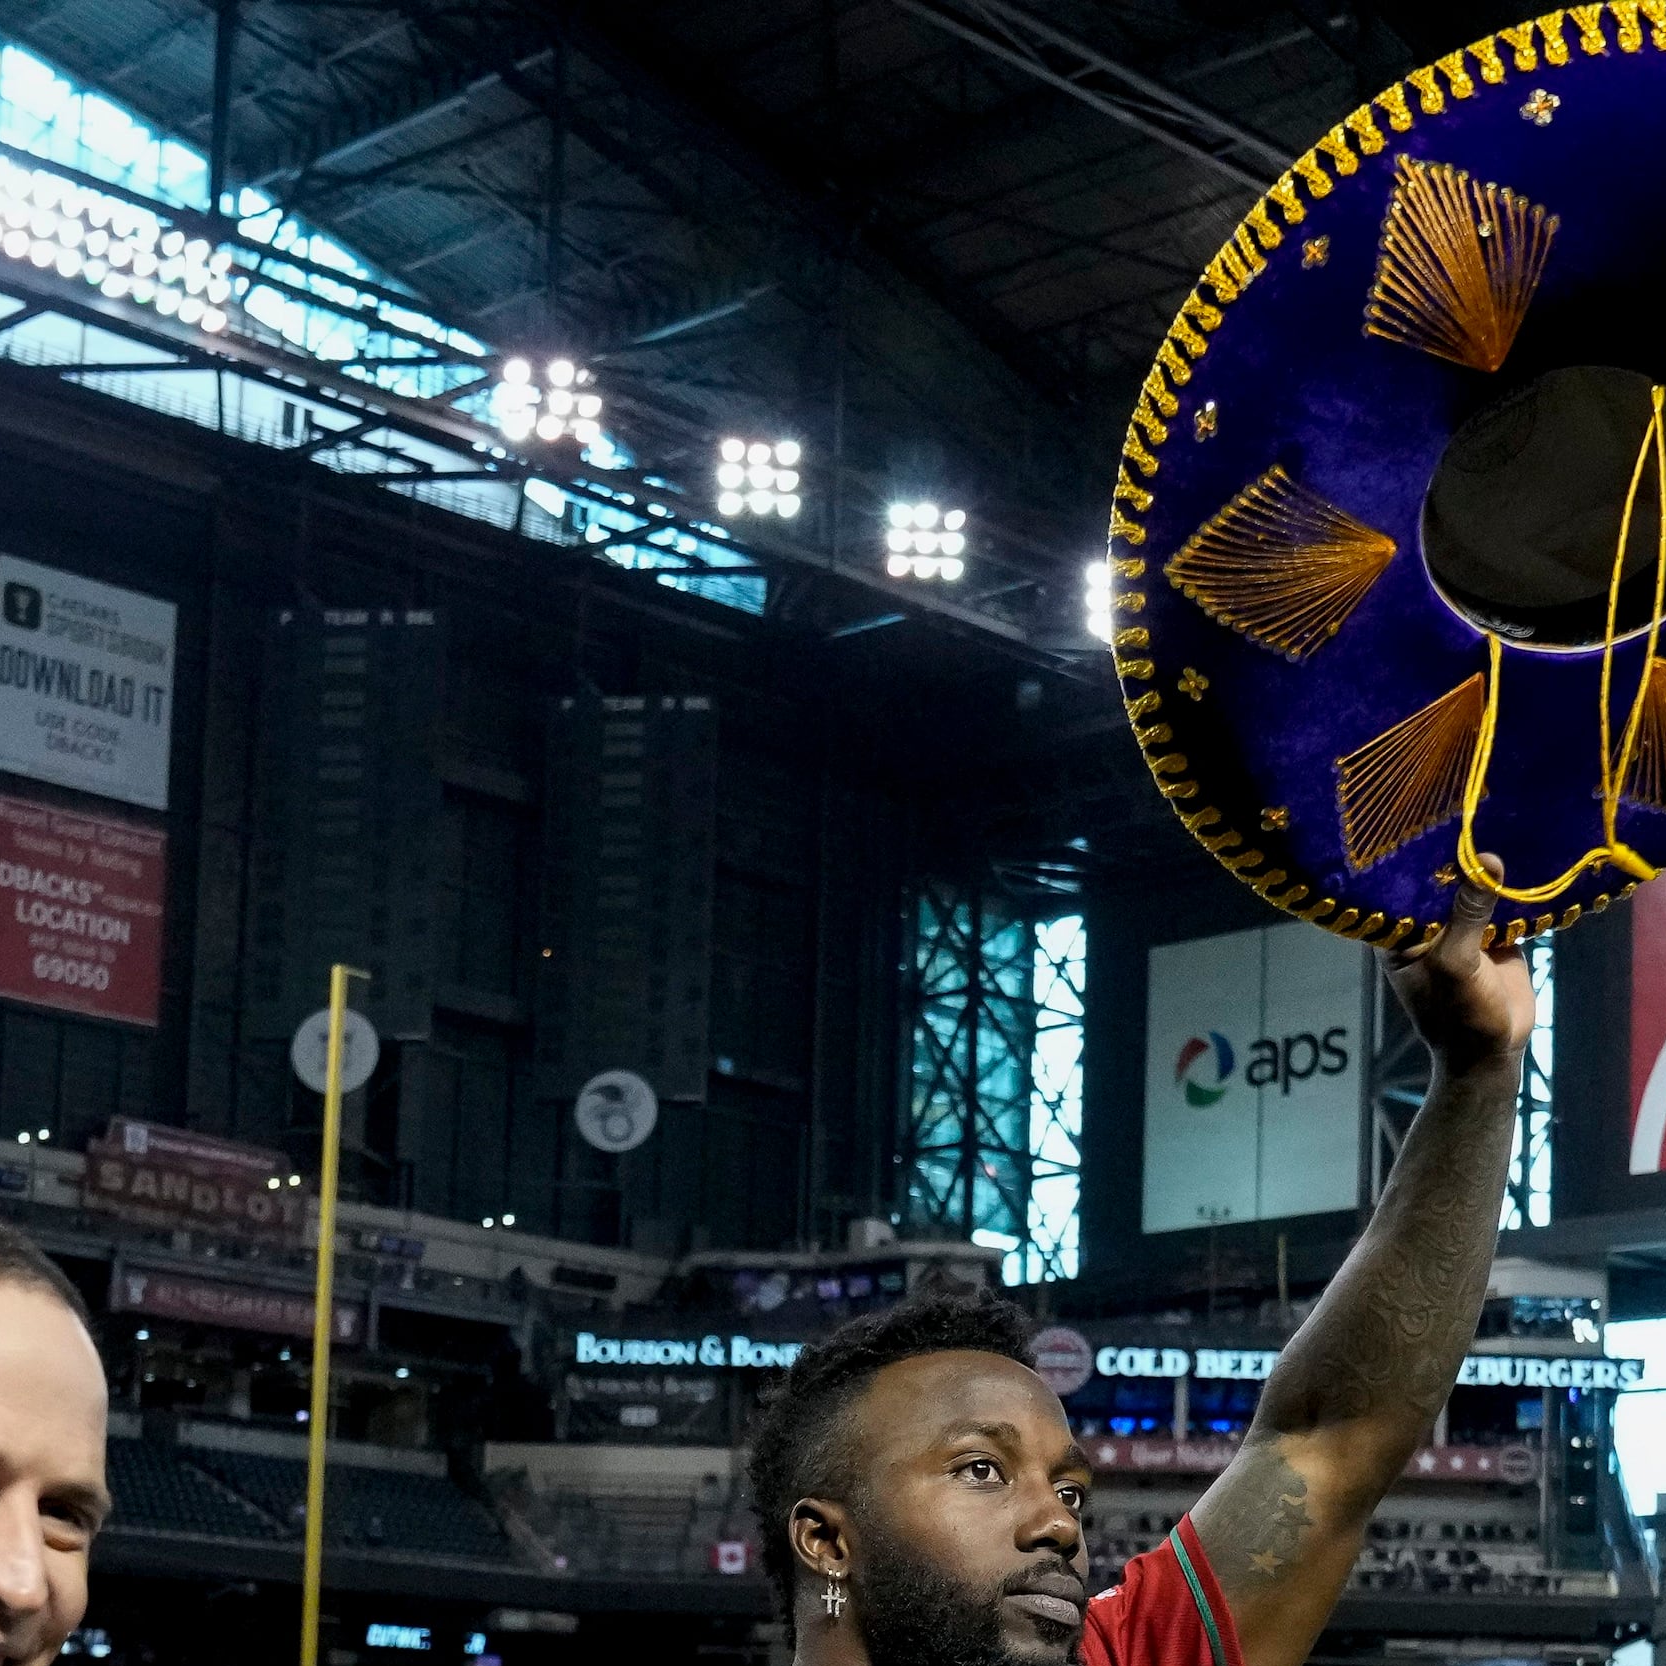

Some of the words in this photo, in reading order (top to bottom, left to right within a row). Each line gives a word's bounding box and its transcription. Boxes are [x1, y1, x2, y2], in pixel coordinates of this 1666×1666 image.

[142, 682, 165, 727] IT
[14, 898, 132, 945] LOCATION
[33, 953, 111, 992] 69050
[1245, 1026, 1349, 1097] aps
[98, 1158, 302, 1224] SANDLOT
[698, 1334, 728, 1367] &
[1095, 1346, 1190, 1378] COLD
[1454, 1356, 1642, 1389] EBURGERS
